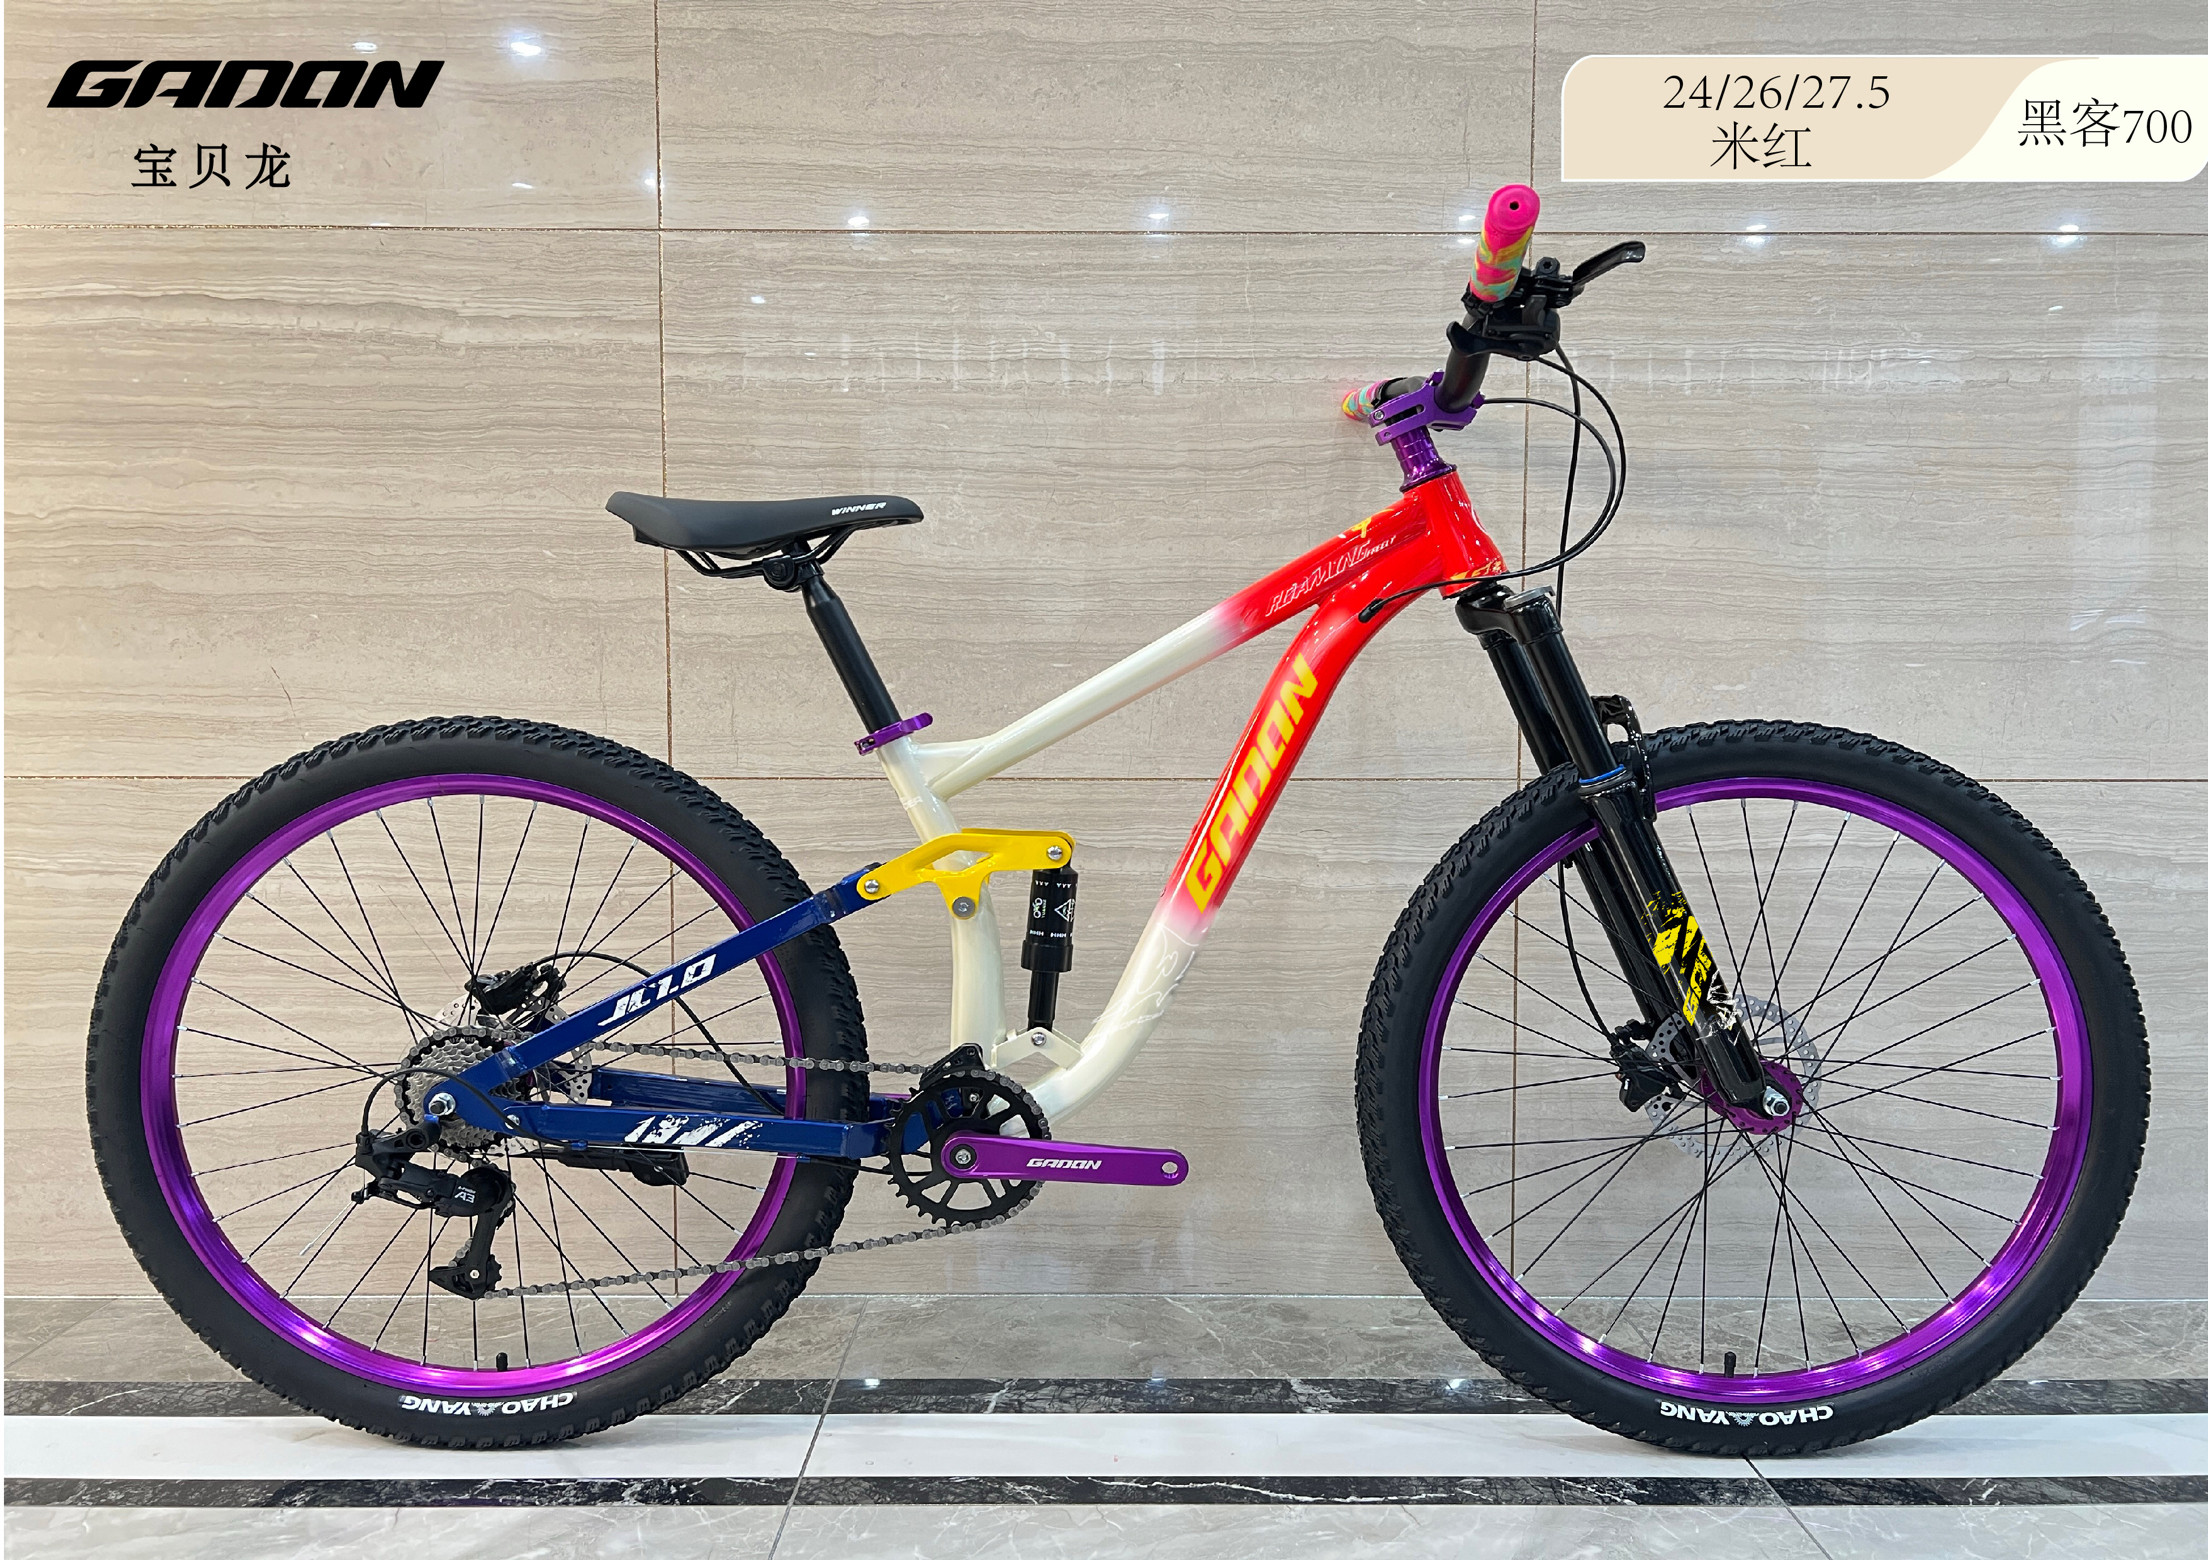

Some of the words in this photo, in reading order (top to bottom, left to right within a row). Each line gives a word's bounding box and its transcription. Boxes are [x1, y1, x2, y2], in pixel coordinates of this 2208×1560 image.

[831, 501, 887, 516] WINNER
[1185, 652, 1318, 914] GADON
[1026, 1158, 1102, 1170] GADON
[454, 1190, 475, 1204] A3
